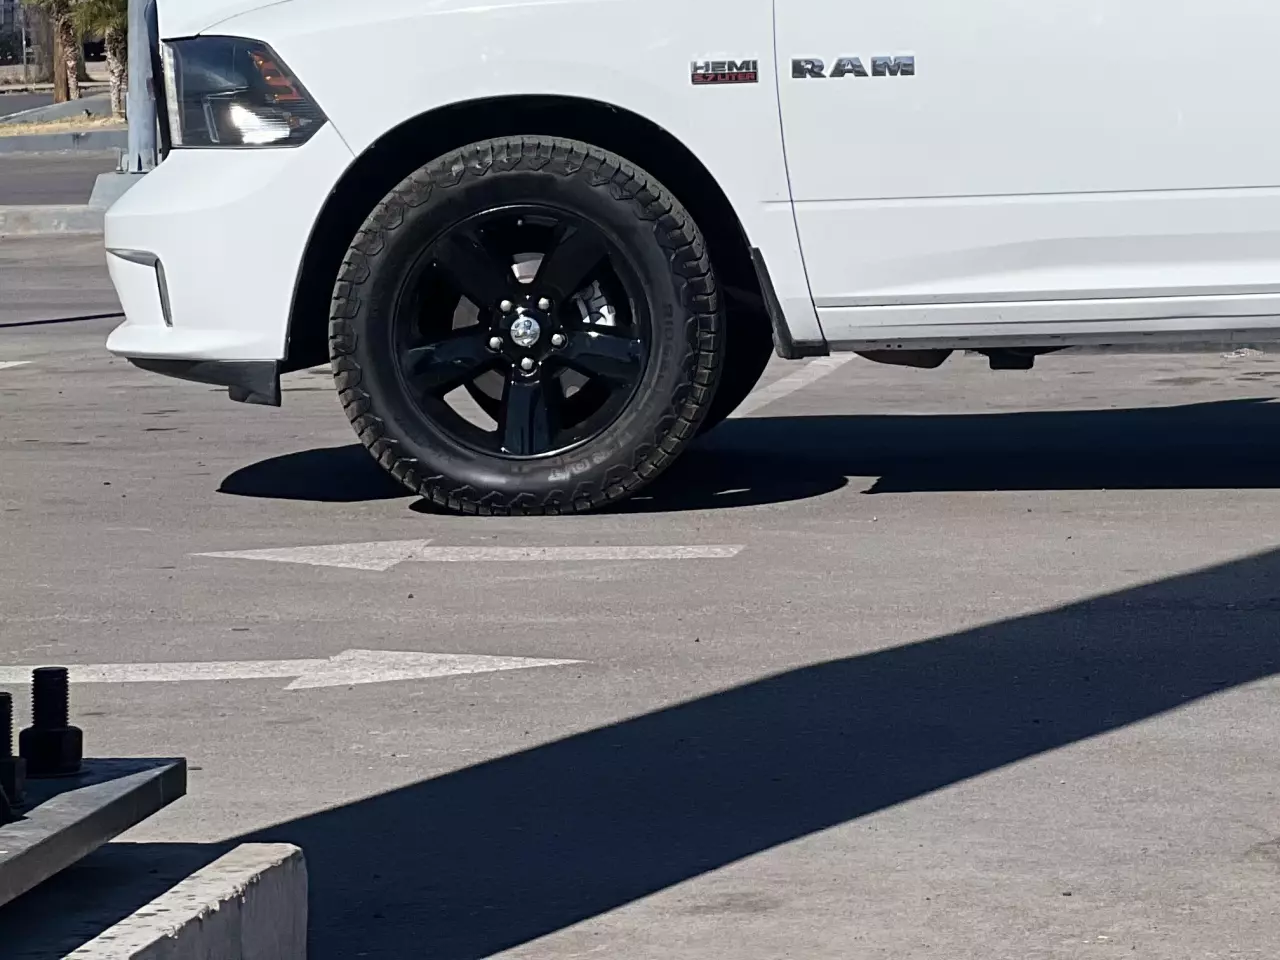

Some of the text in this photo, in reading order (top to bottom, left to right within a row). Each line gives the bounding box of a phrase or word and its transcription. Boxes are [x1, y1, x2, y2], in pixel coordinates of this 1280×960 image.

[691, 60, 758, 72] HEMI
[792, 56, 915, 78] RAM
[717, 72, 755, 81] LITER
